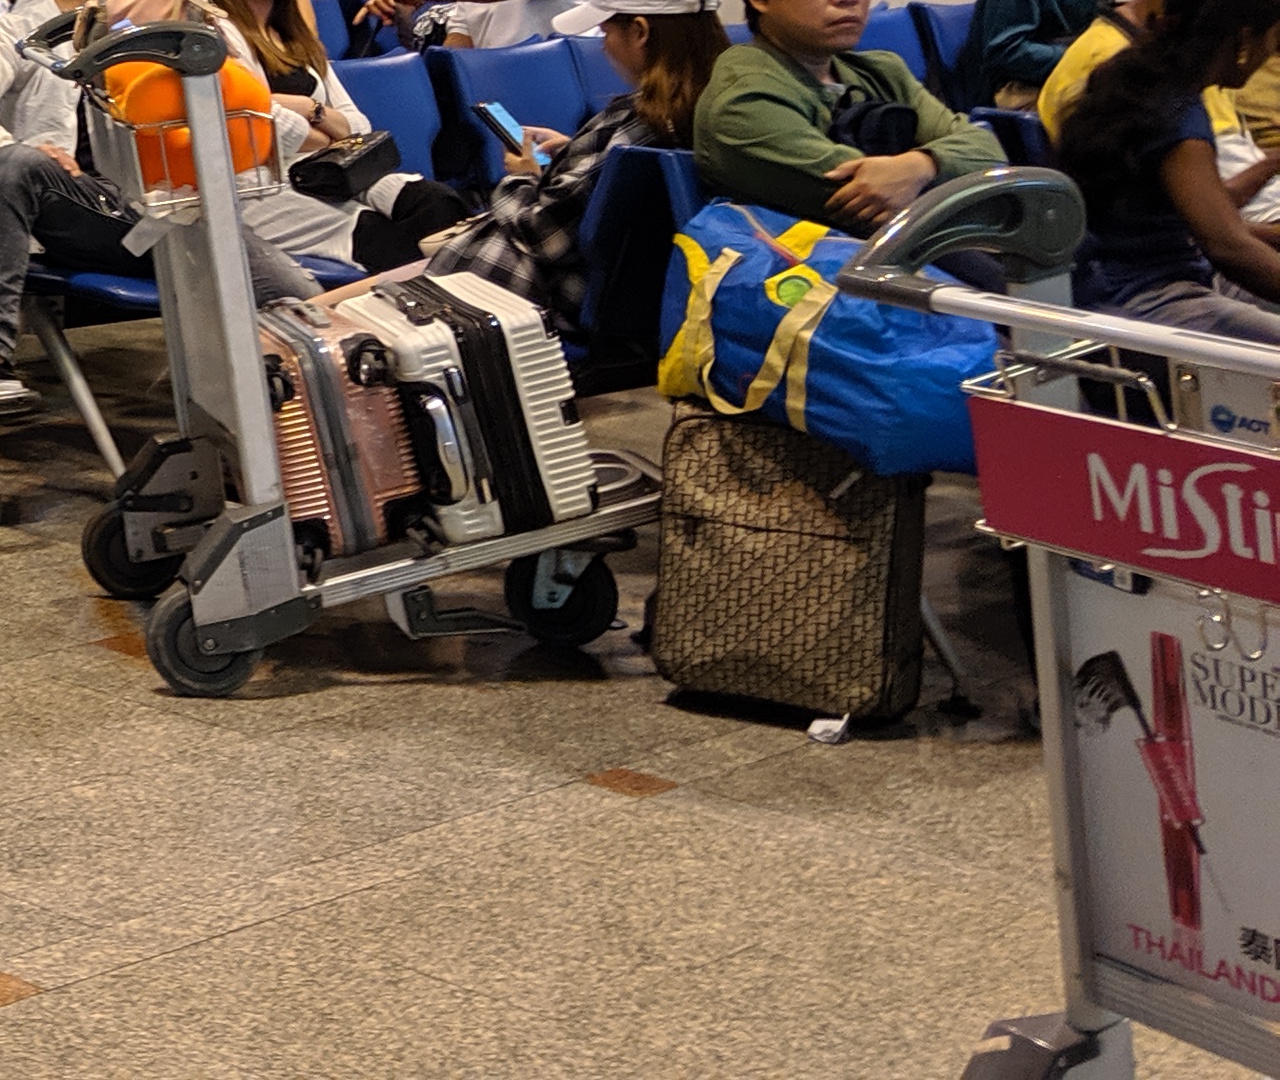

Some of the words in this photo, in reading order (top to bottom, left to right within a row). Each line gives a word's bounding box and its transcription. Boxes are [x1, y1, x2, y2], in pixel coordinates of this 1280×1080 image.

[1238, 416, 1270, 435] AOT
[1191, 682, 1280, 732] MOD
[1127, 923, 1280, 1003] THAILAND
[1239, 927, 1280, 970] 泰
